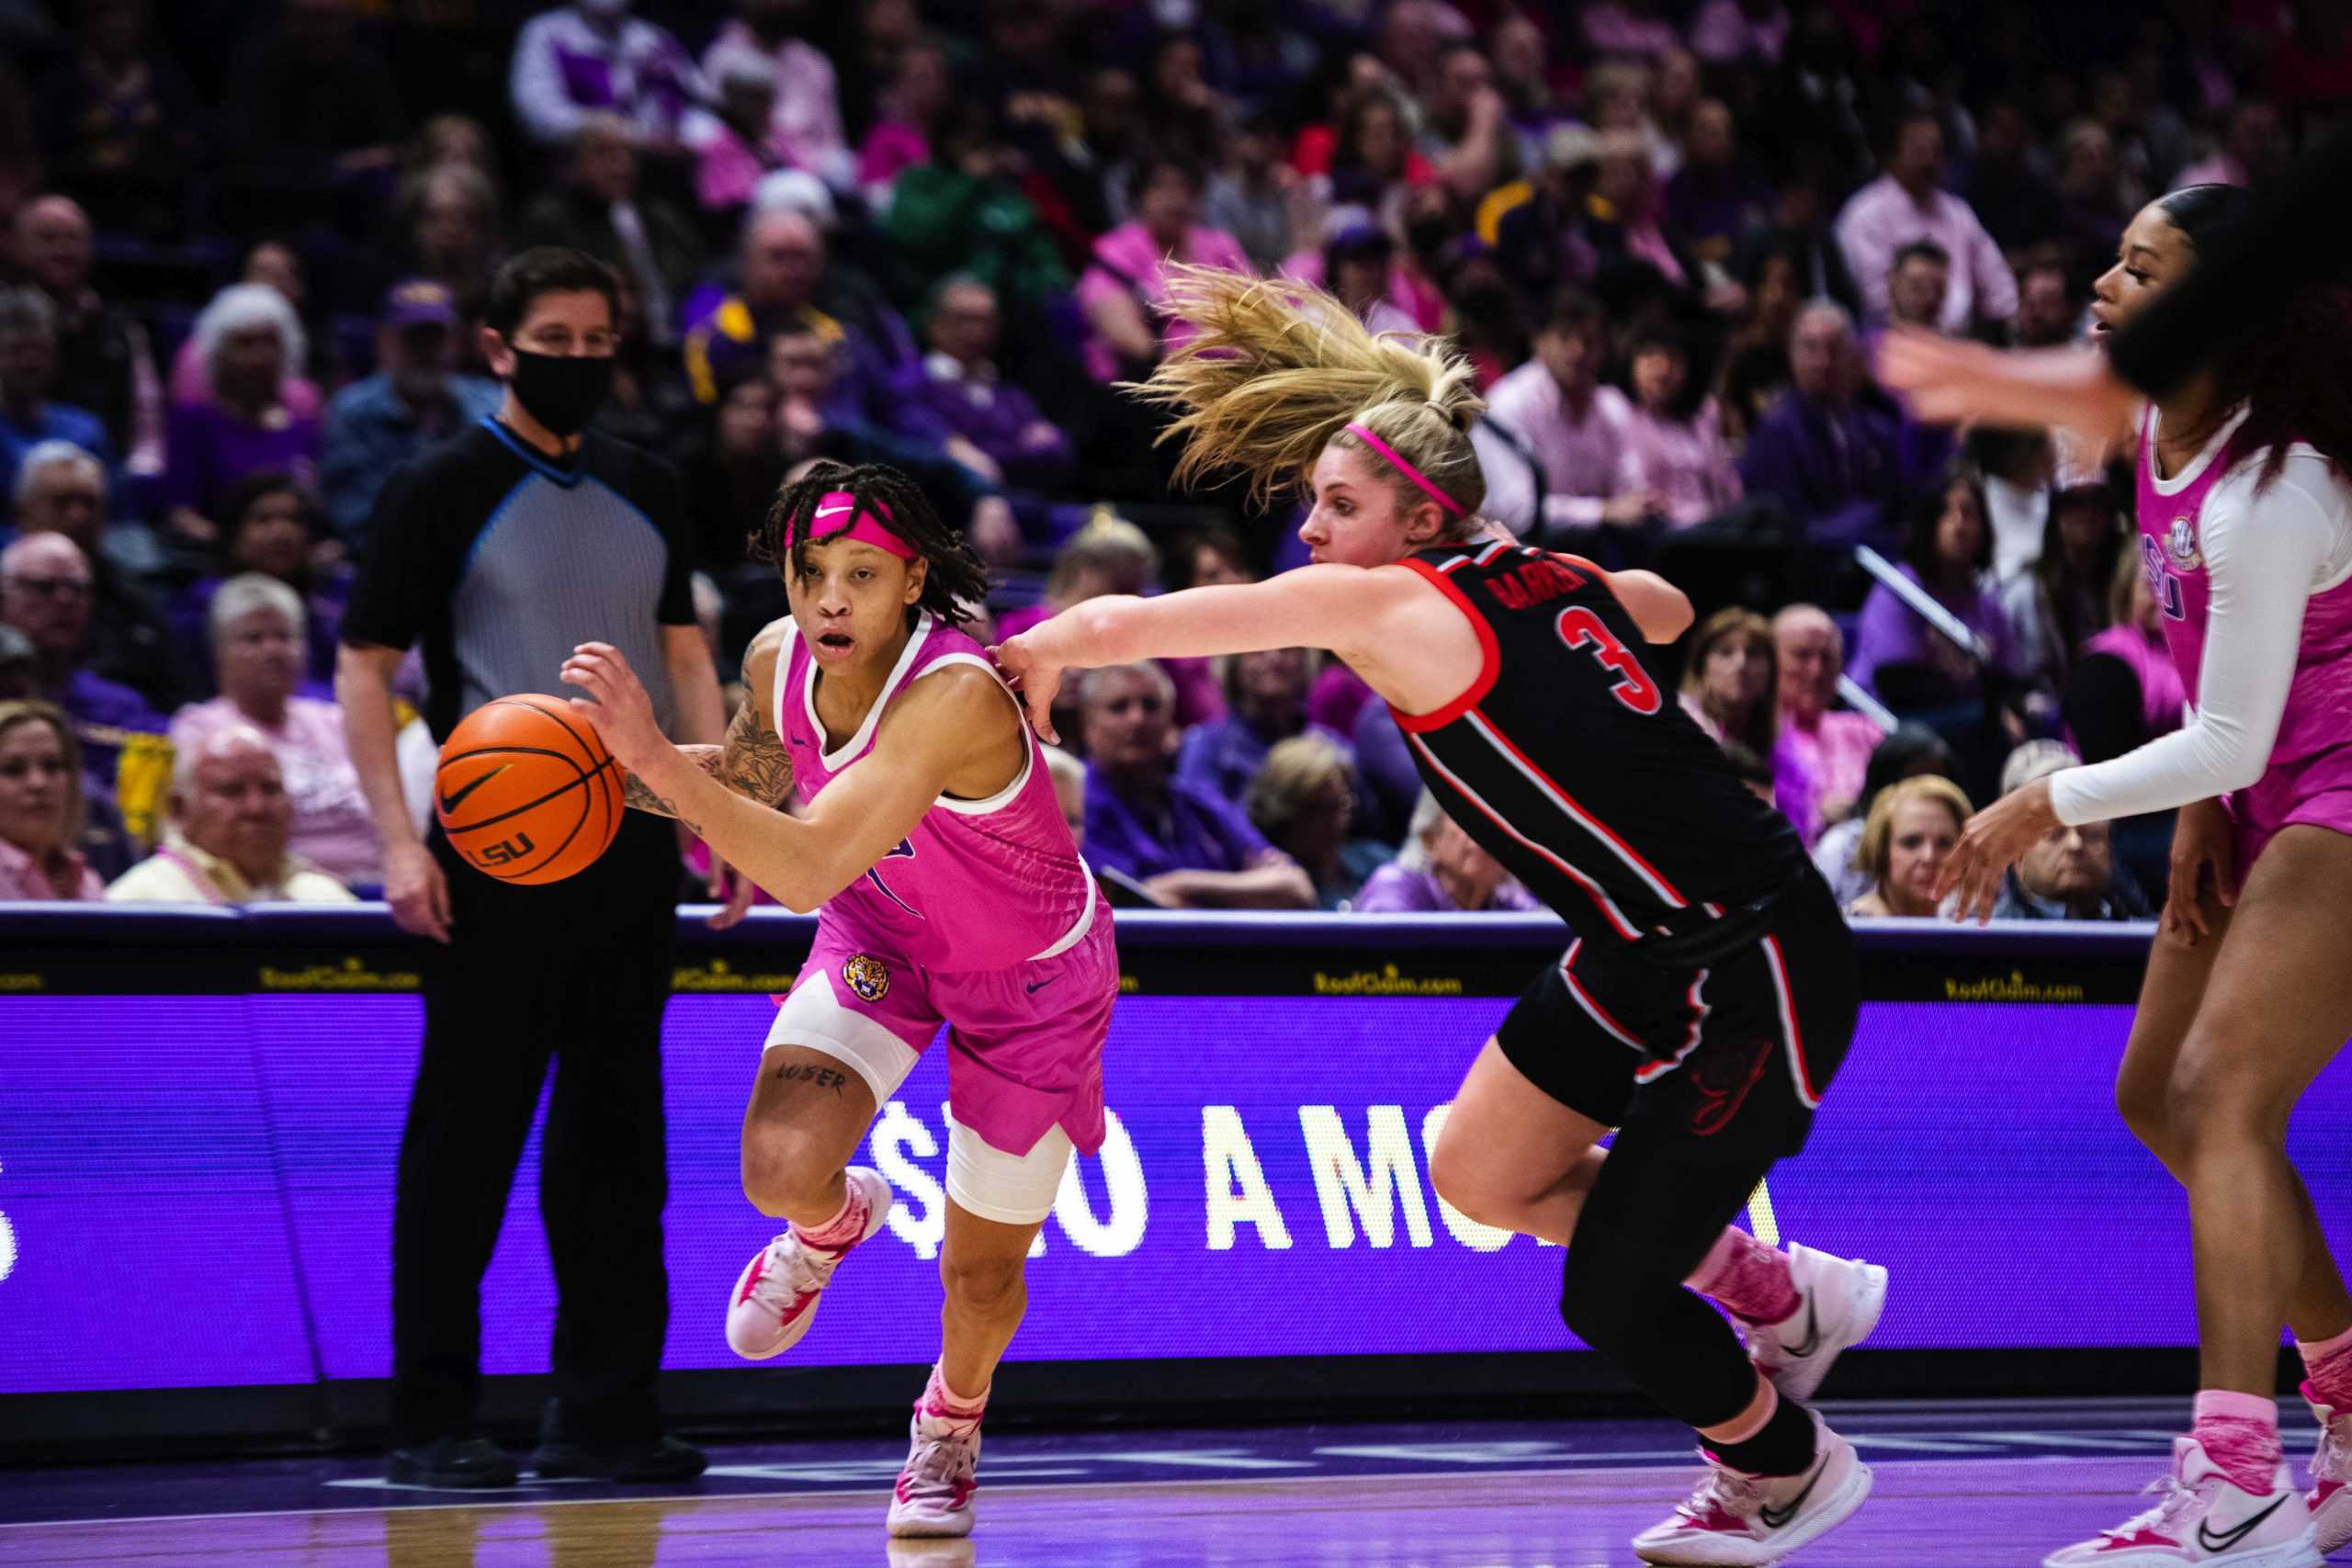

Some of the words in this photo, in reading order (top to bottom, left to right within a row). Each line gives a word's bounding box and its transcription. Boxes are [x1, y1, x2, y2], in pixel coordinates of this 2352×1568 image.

[1555, 604, 1662, 716] 3
[464, 831, 535, 868] LSU
[869, 1100, 1148, 1260] $0
[1202, 1105, 1293, 1250] A
